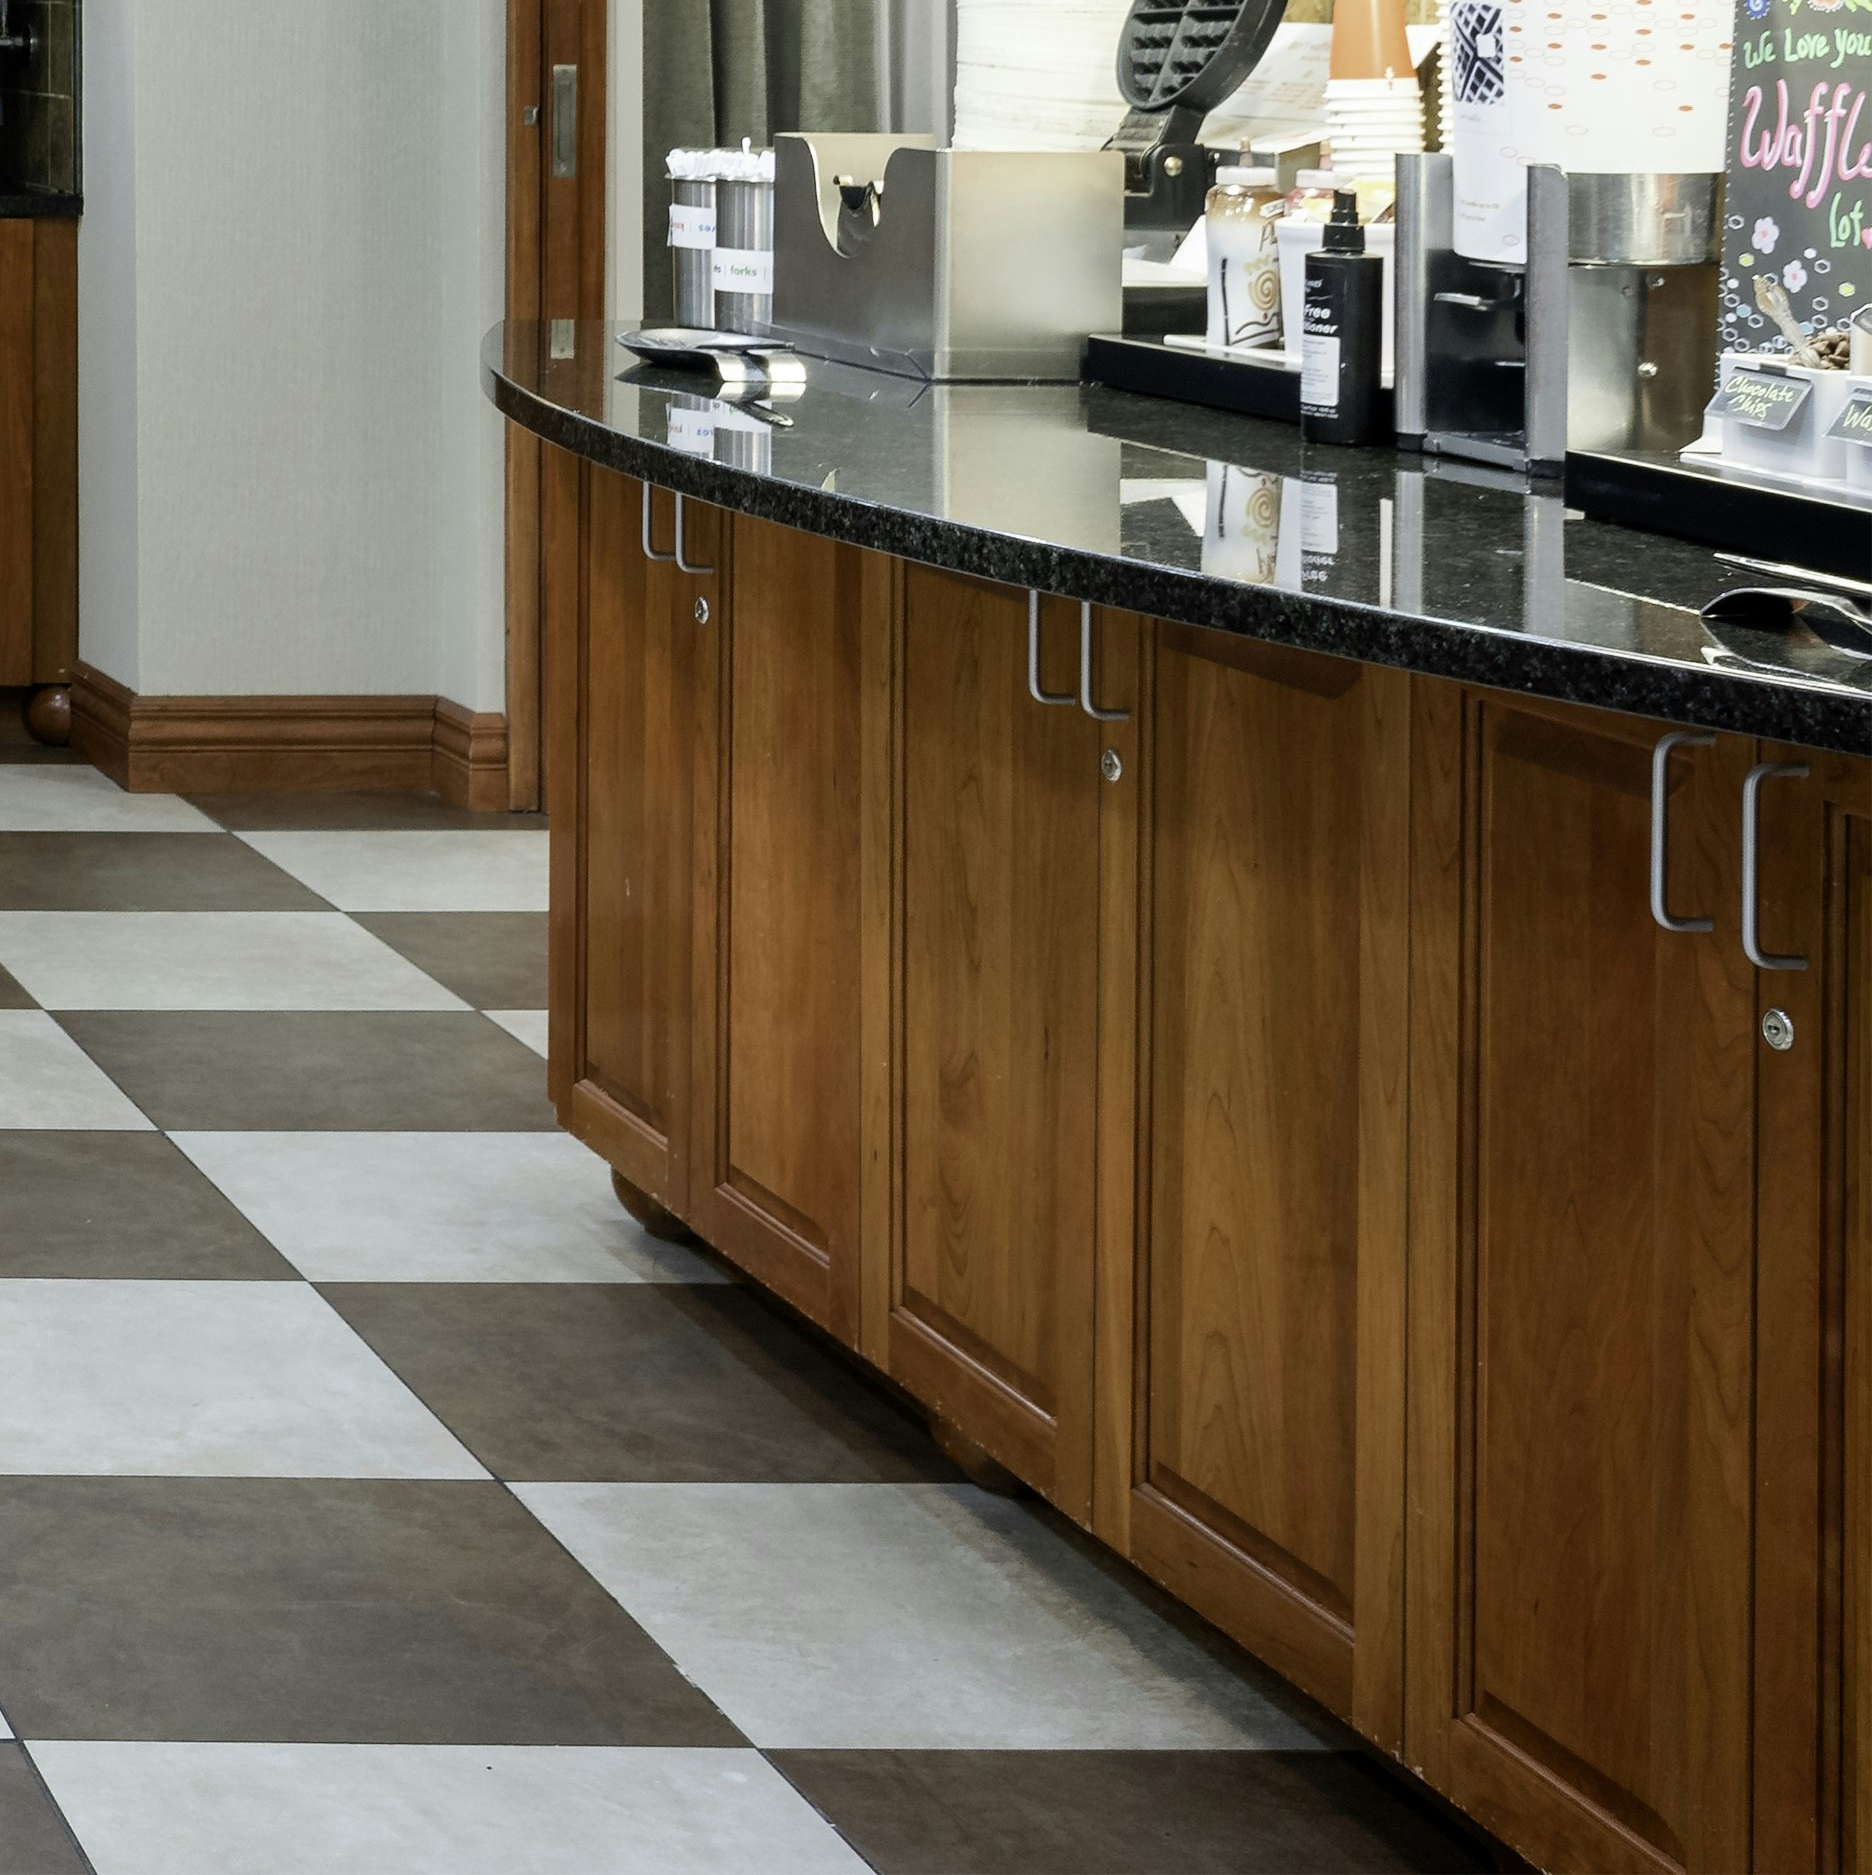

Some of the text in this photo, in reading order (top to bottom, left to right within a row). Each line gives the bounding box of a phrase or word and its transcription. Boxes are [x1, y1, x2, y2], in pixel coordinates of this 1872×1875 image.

[1743, 30, 1776, 69] We
[1784, 27, 1830, 62] Love
[1829, 191, 1864, 249] Lot
[730, 266, 758, 277] forks
[1724, 376, 1795, 403] Chocolate
[1727, 394, 1773, 419] Chips
